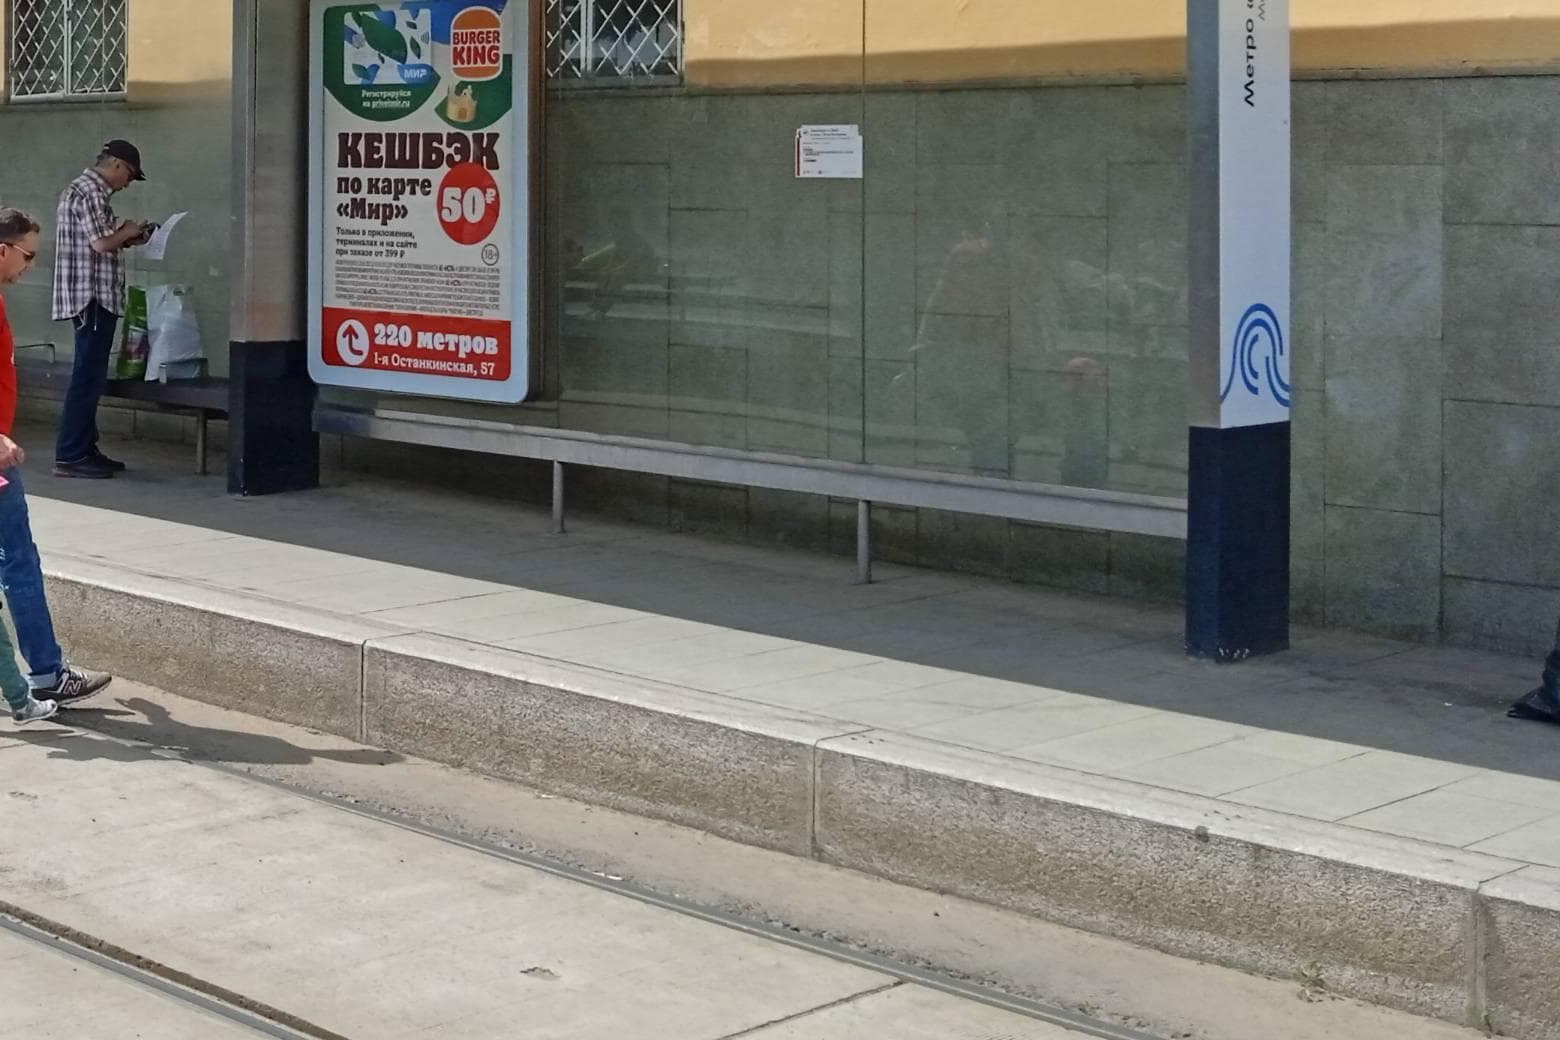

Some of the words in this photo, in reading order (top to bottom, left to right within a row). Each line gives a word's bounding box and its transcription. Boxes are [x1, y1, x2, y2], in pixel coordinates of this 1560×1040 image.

[453, 30, 501, 45] BURGER
[452, 45, 500, 65] KING
[1243, 19, 1257, 107] Метро
[403, 68, 428, 79] МИР
[337, 132, 500, 170] КЕШБЭК
[337, 176, 362, 195] по
[367, 177, 432, 201] карте
[336, 197, 409, 226] «Мир»
[336, 226, 361, 236] Только
[336, 238, 378, 248] терминалах
[396, 239, 418, 249] сайте
[336, 248, 349, 257] при
[484, 249, 498, 260] 18+
[373, 322, 412, 347] 220
[416, 331, 499, 358] метров
[374, 352, 389, 365] 1-я
[391, 353, 478, 376] Останкинская,
[480, 361, 495, 376] 57
